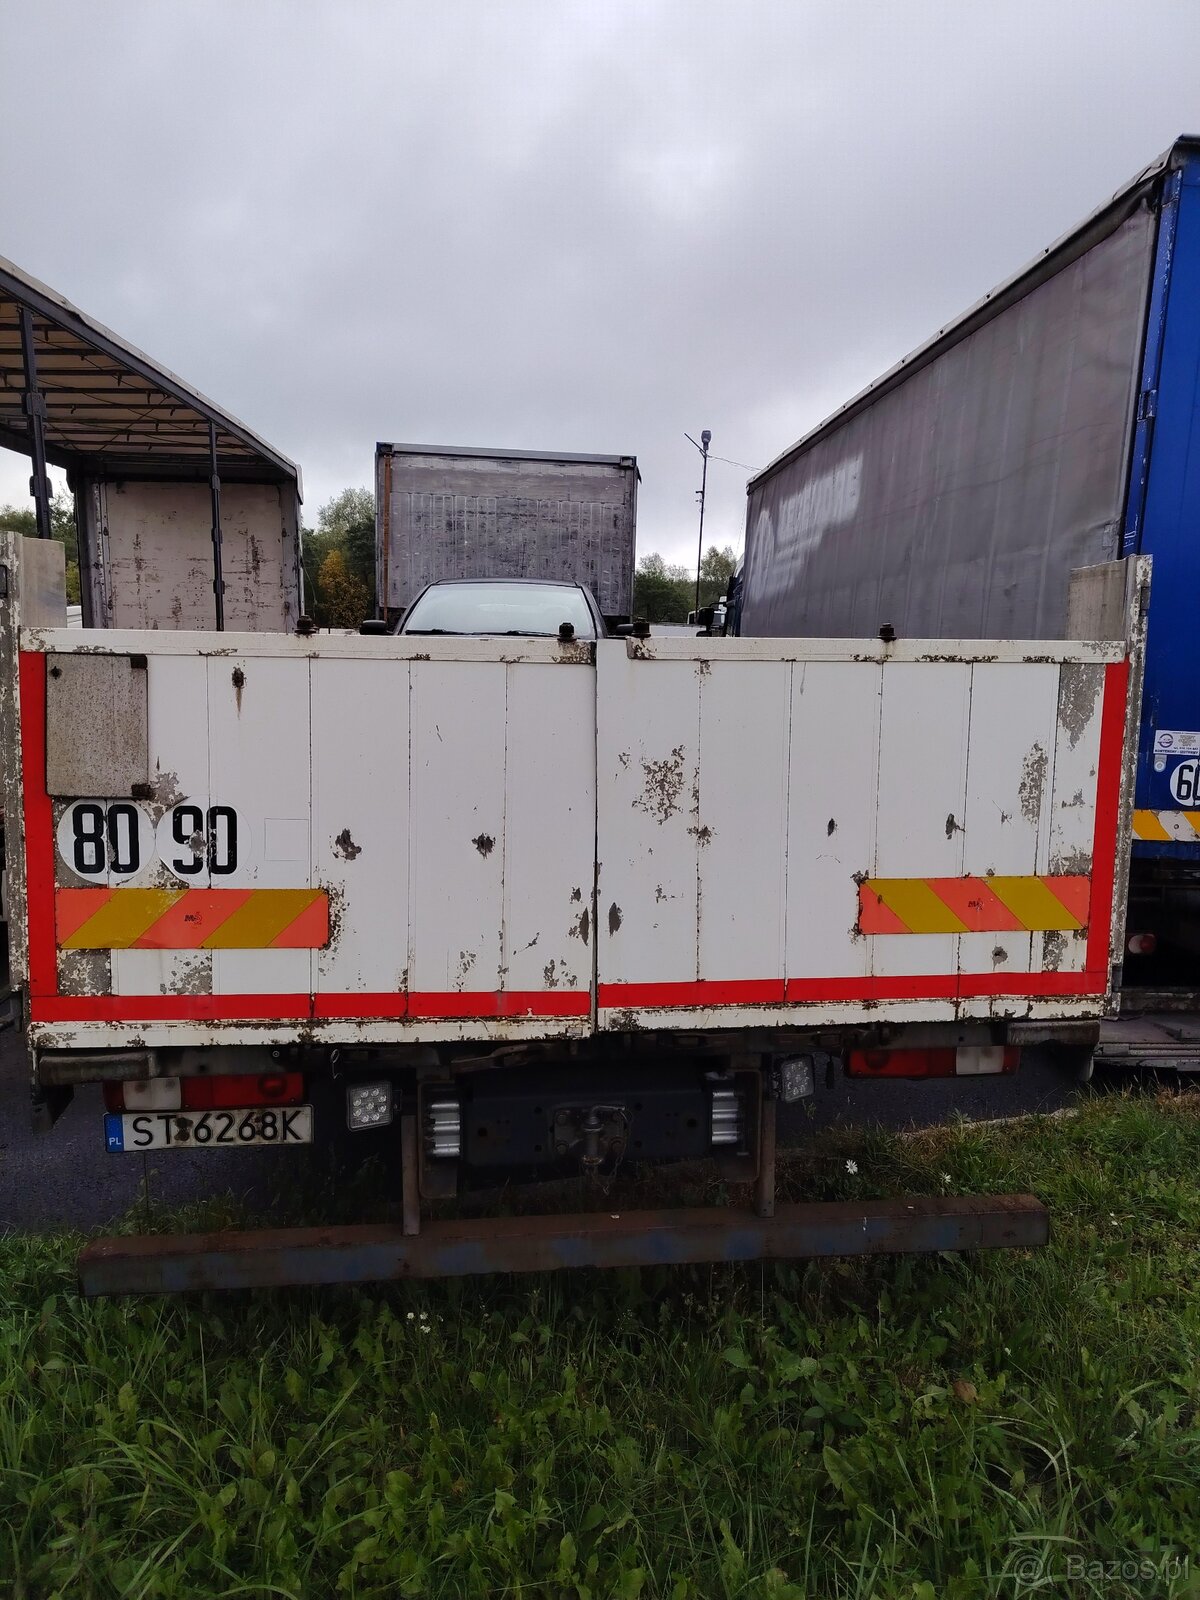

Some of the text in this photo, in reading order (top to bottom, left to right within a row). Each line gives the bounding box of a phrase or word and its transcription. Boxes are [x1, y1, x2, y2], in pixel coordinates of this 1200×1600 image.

[72, 803, 140, 874] 80
[172, 805, 238, 875] 90
[108, 1137, 122, 1146] PL
[132, 1110, 302, 1146] ST 6268K
